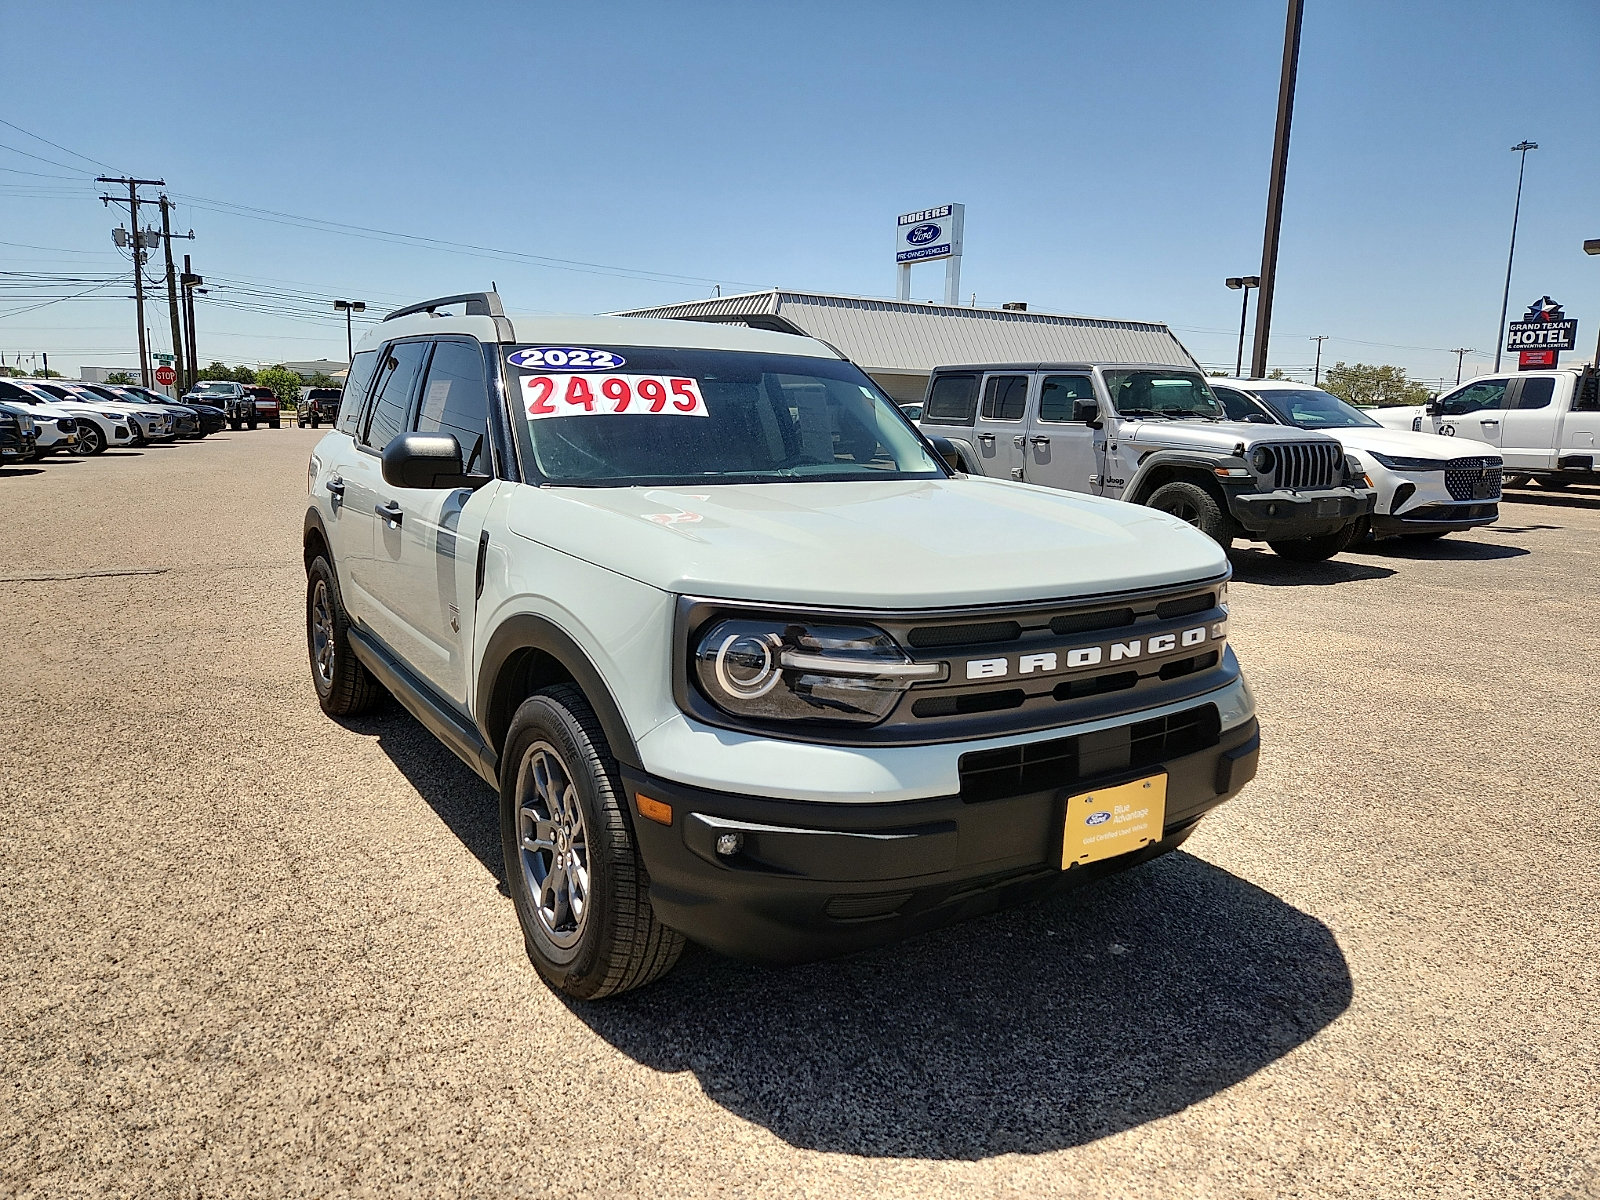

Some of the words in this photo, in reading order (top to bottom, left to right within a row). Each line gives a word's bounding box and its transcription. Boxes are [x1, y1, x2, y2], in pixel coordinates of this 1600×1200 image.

[899, 206, 949, 225] ROGERS
[912, 226, 935, 243] Ford
[897, 250, 926, 260] PRE-OWNED
[925, 245, 949, 256] VEHICLES
[1510, 323, 1541, 331] GRAND
[1542, 321, 1572, 330] TEXAN
[1508, 329, 1569, 344] HOTEL
[520, 350, 615, 367] 2022
[156, 371, 176, 380] STOP
[527, 376, 698, 414] 24995
[1106, 476, 1125, 485] Jeep
[966, 626, 1207, 680] BRONCO
[1113, 808, 1149, 824] Advantage
[1114, 804, 1130, 815] Blue
[1088, 813, 1108, 824] Ford
[1082, 835, 1096, 845] Gold
[1096, 831, 1119, 842] Certified
[1118, 827, 1132, 836] Used
[1131, 823, 1149, 832] Vehicle
